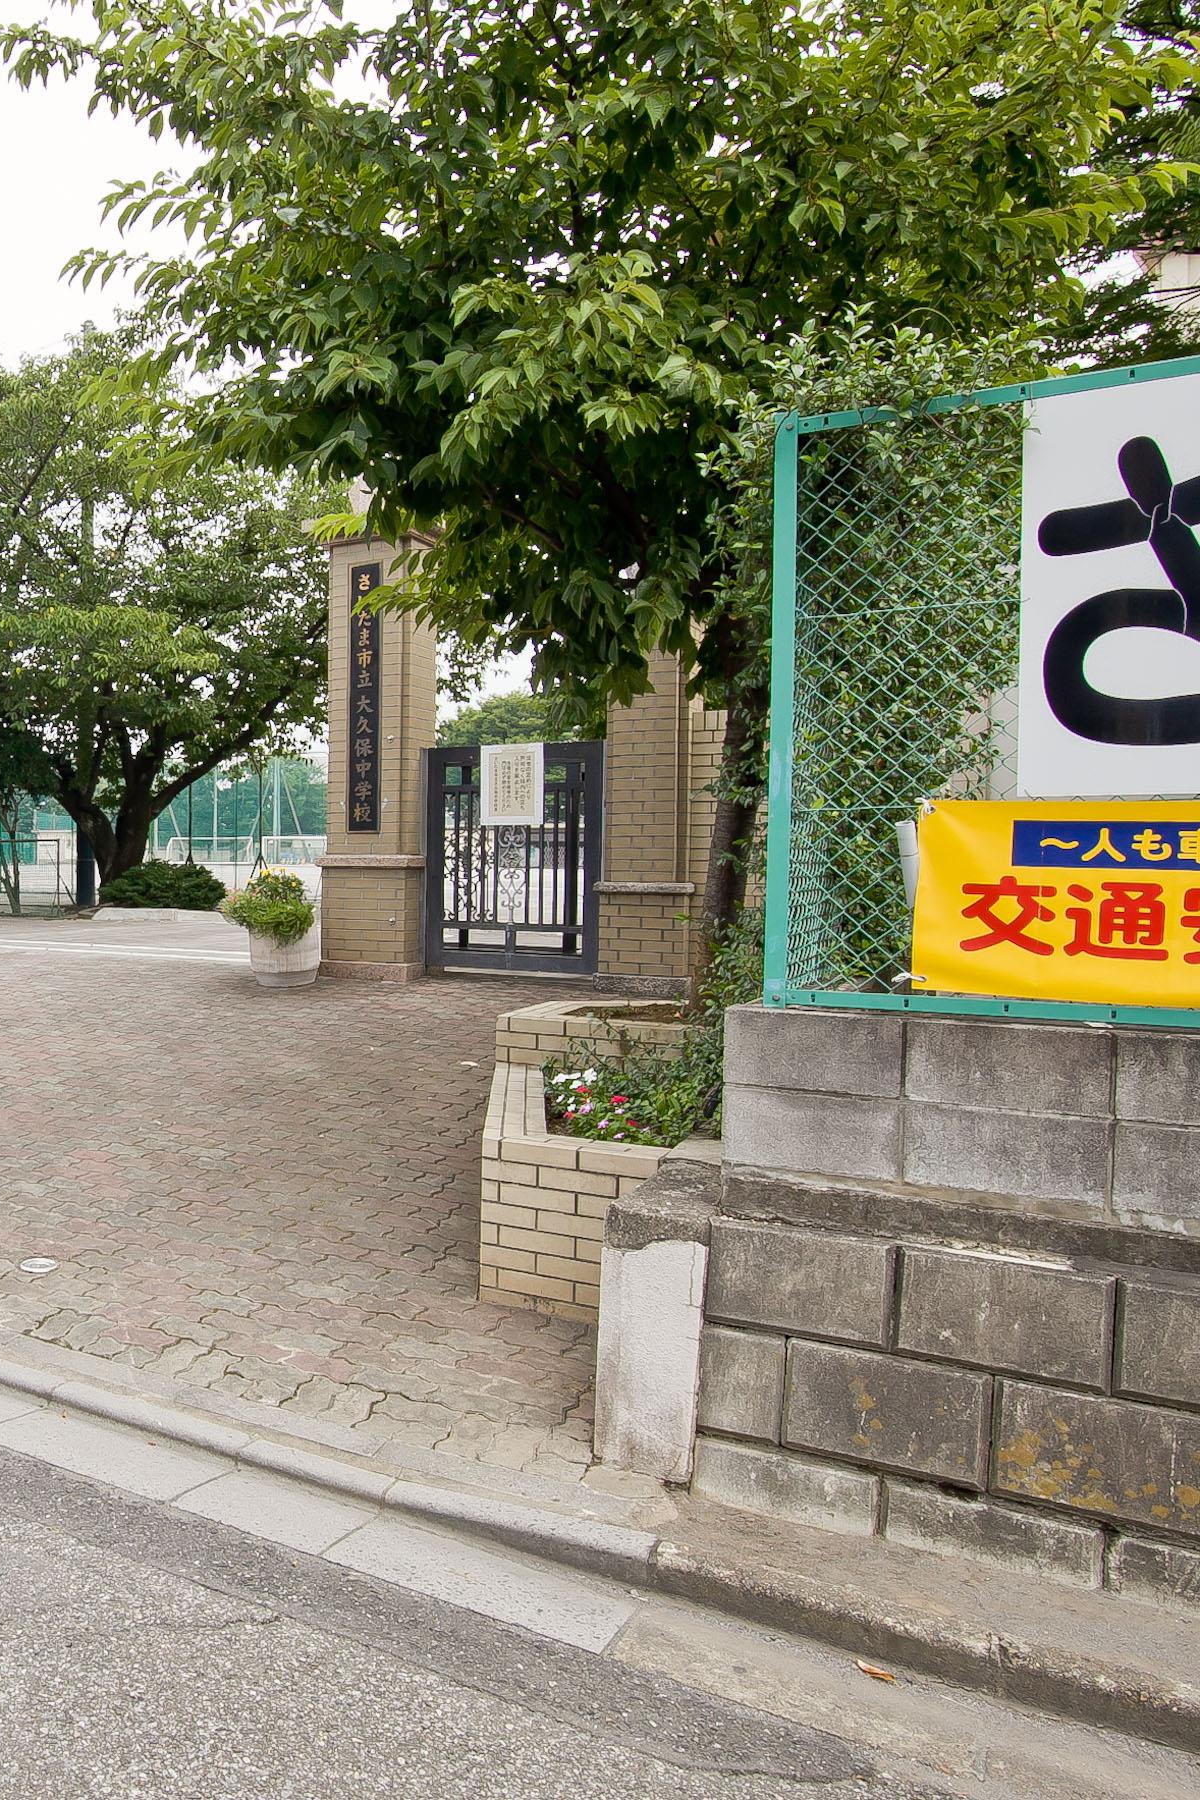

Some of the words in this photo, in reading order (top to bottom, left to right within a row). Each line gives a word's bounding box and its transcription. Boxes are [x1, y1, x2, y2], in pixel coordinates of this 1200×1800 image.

[353, 573, 374, 823] さたま市立大久保中学校
[959, 875, 1200, 964] 交通
